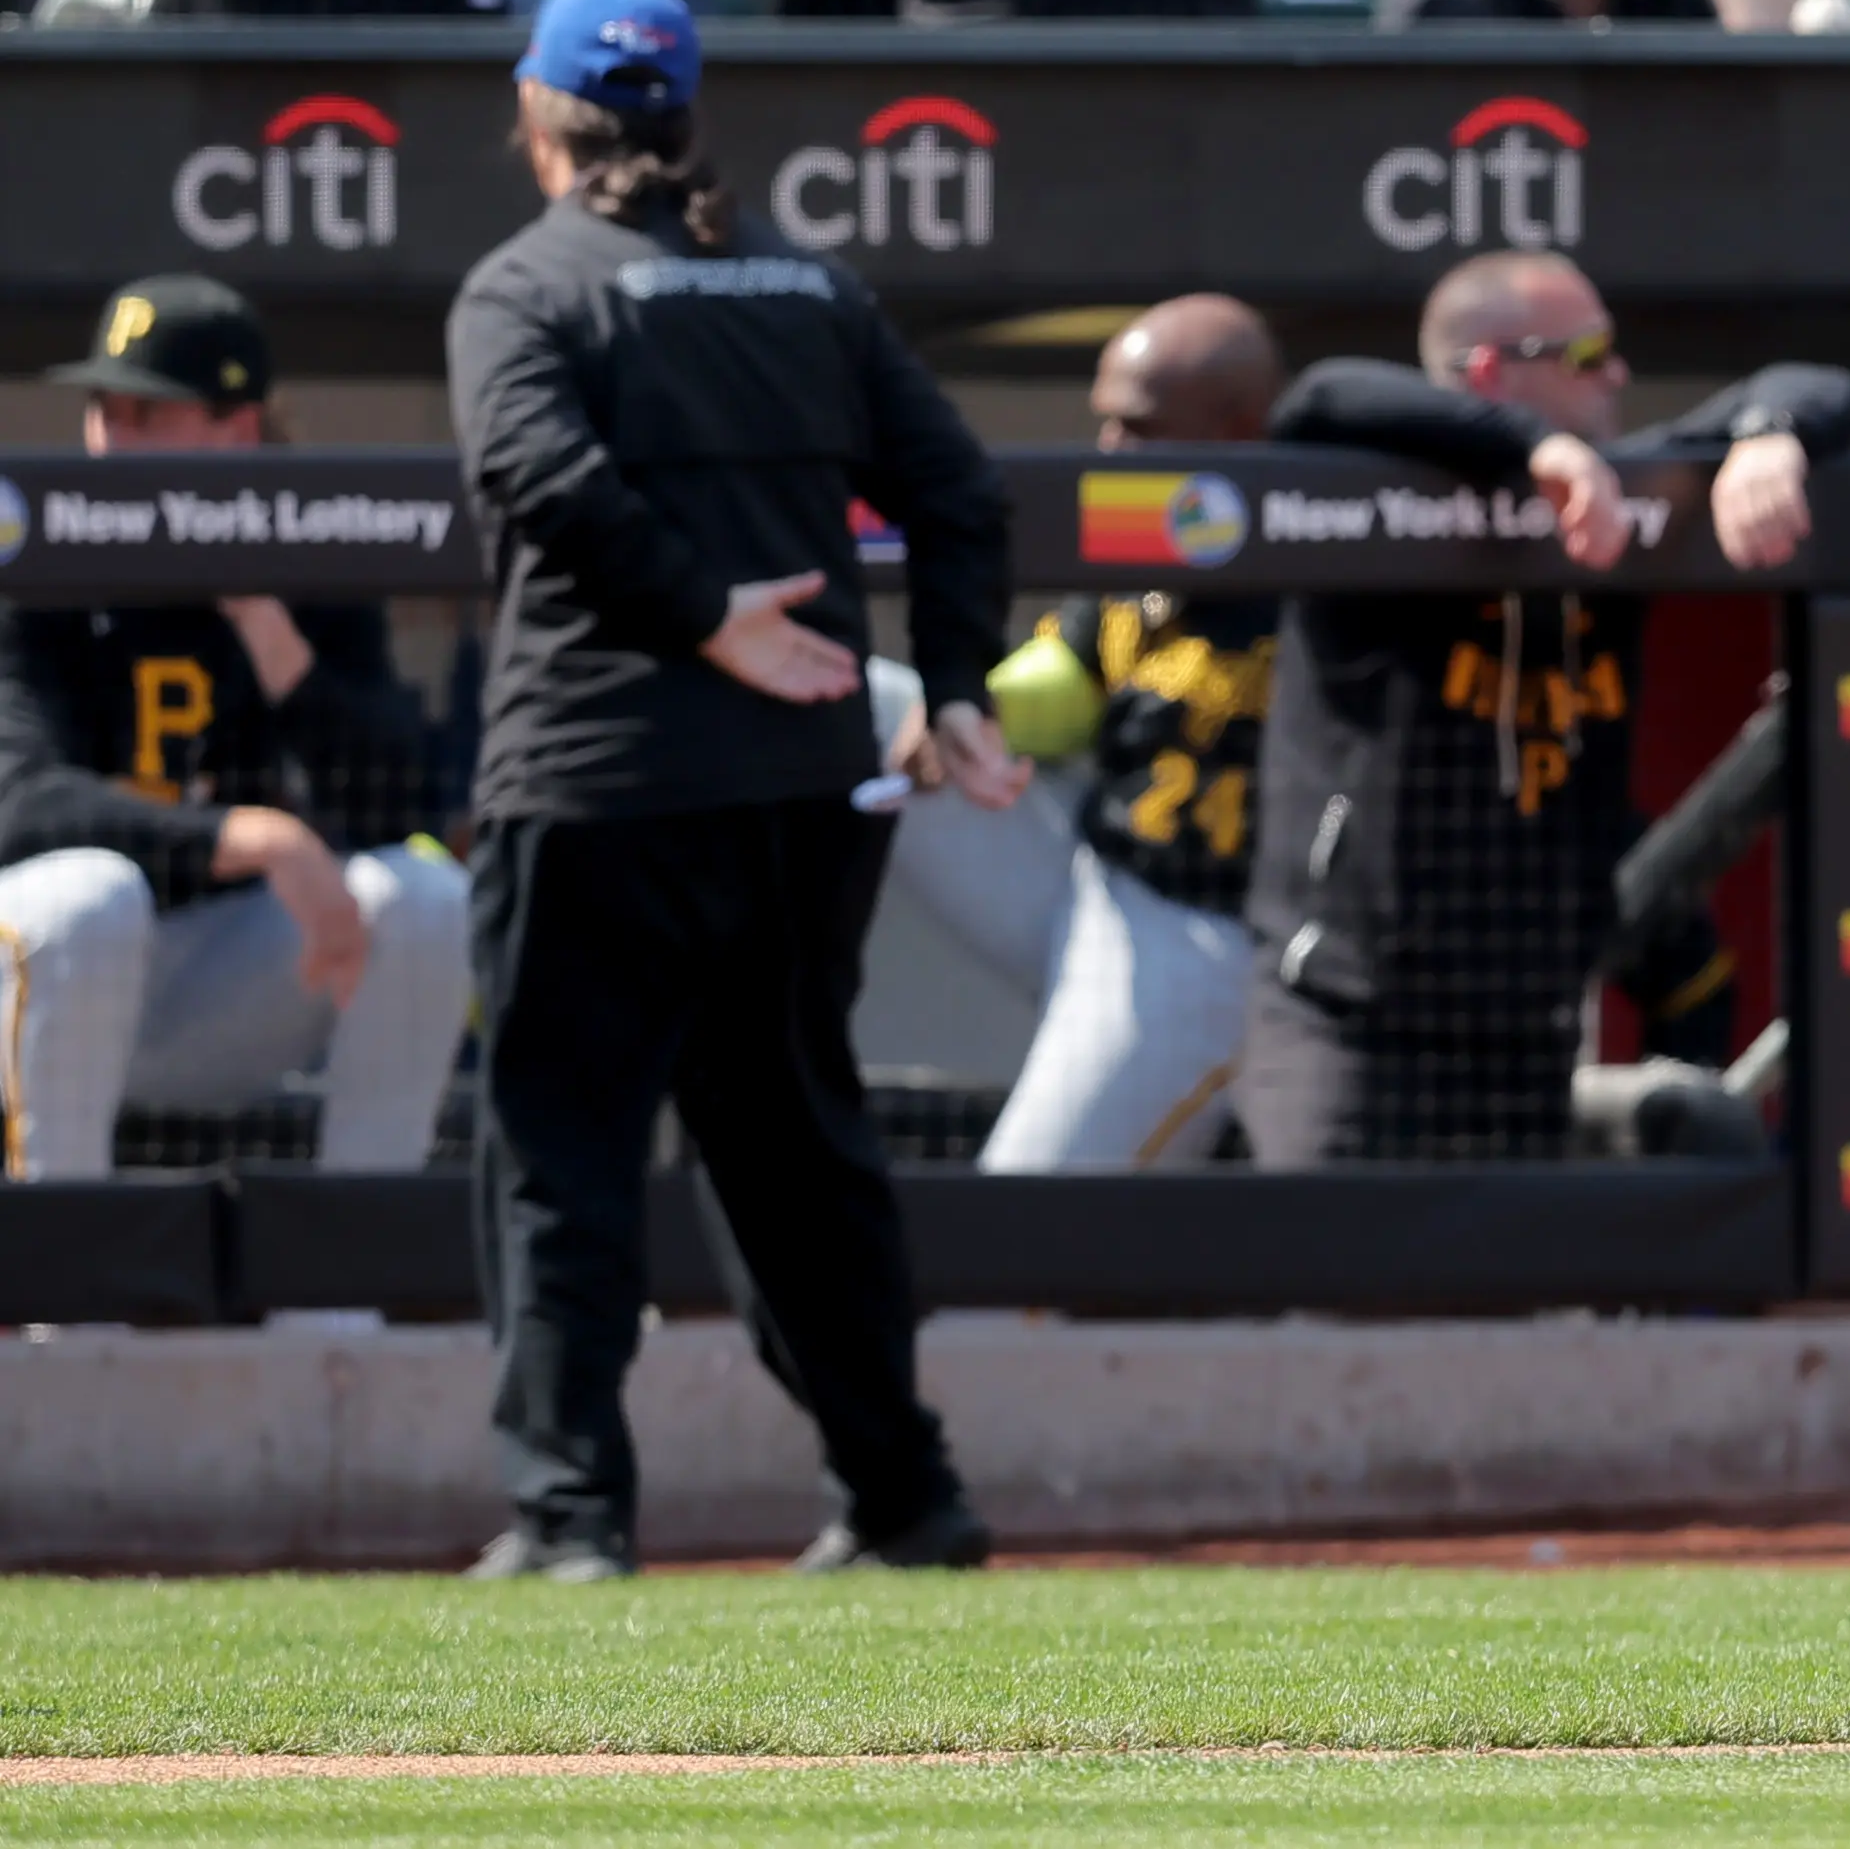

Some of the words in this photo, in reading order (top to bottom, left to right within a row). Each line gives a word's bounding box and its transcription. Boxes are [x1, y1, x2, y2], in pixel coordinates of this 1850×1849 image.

[172, 126, 395, 251] citi
[770, 127, 995, 250] citi
[1363, 127, 1584, 251] citi
[107, 296, 156, 357] P
[43, 489, 157, 544] New
[158, 487, 272, 544] York
[274, 488, 454, 551] Lottery
[1262, 489, 1375, 541] New
[1376, 485, 1489, 539] York
[134, 657, 213, 802] P
